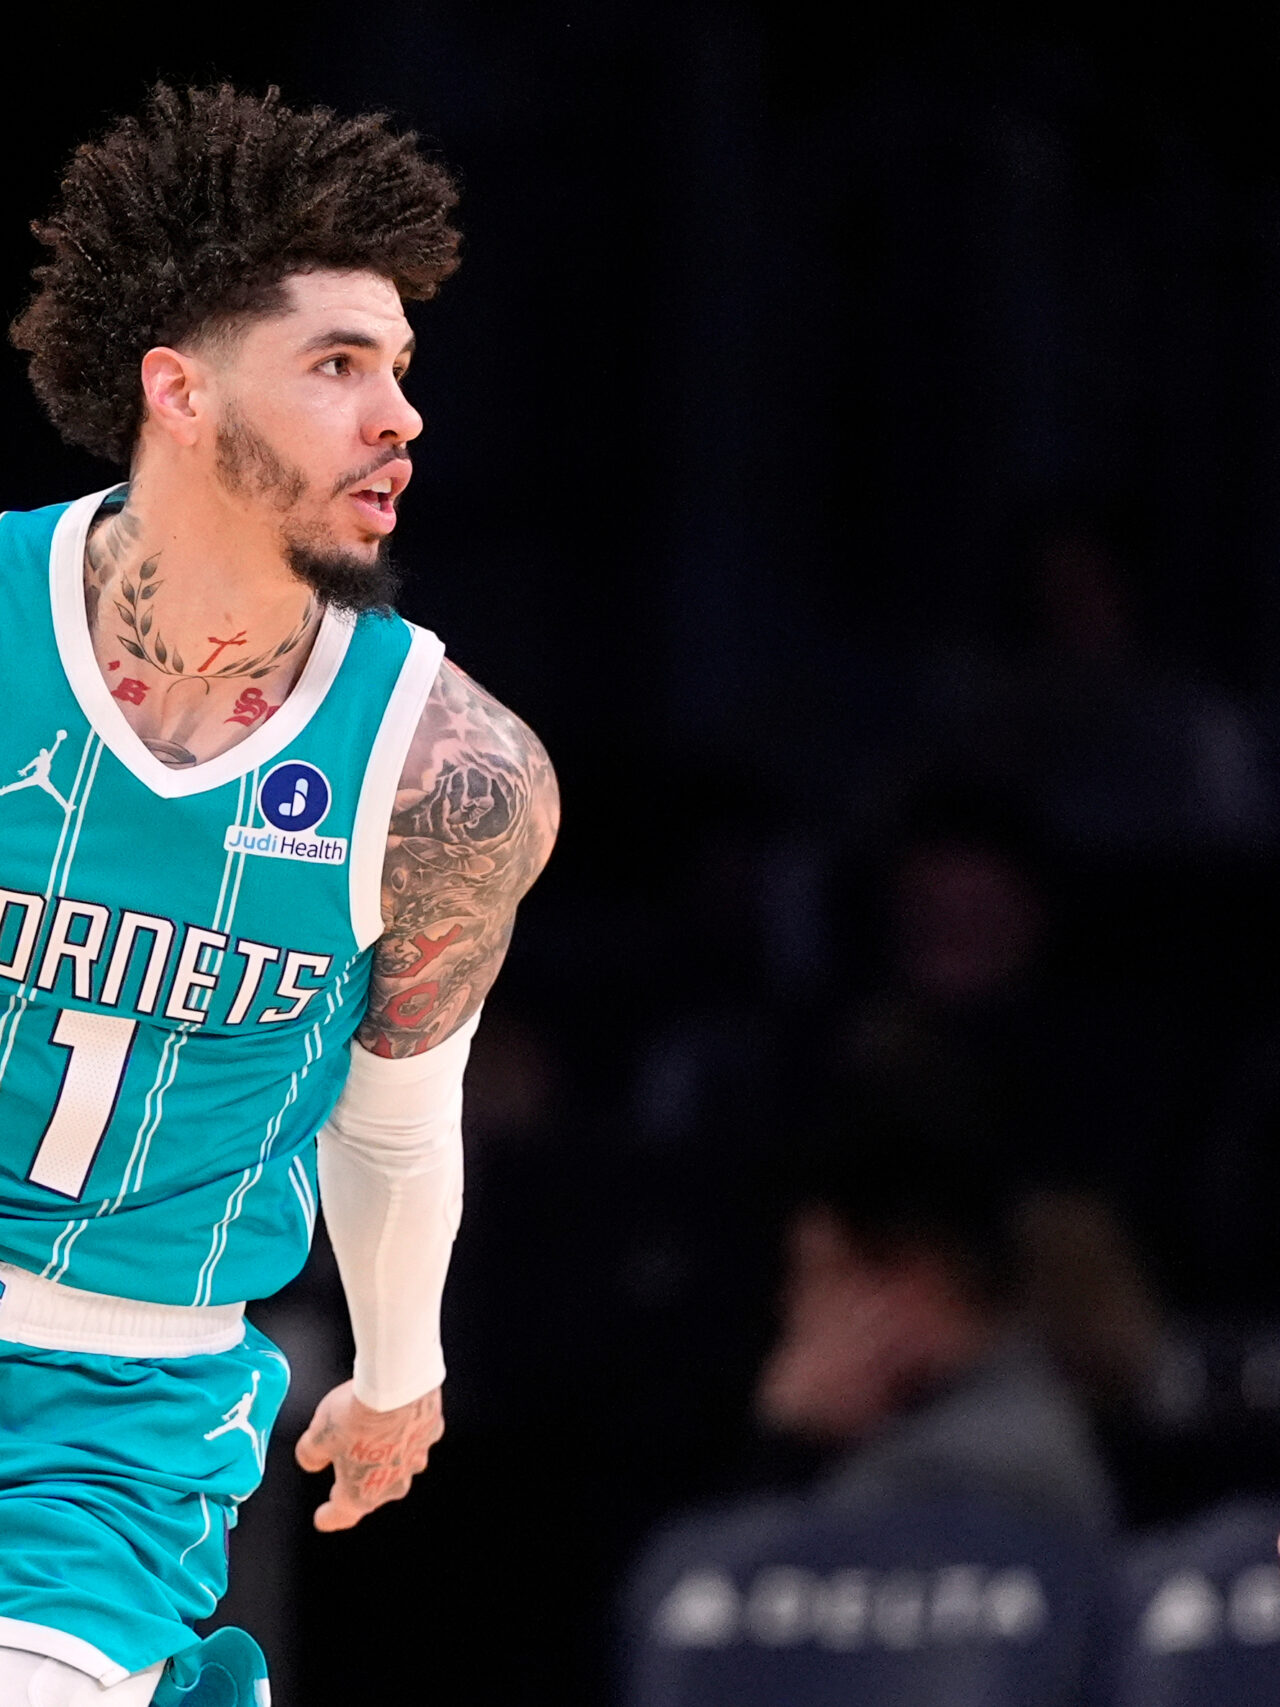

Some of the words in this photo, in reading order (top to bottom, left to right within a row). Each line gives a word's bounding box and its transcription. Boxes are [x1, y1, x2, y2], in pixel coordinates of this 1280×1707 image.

[228, 830, 278, 853] Judi
[280, 836, 343, 860] Health
[26, 1008, 140, 1203] 1
